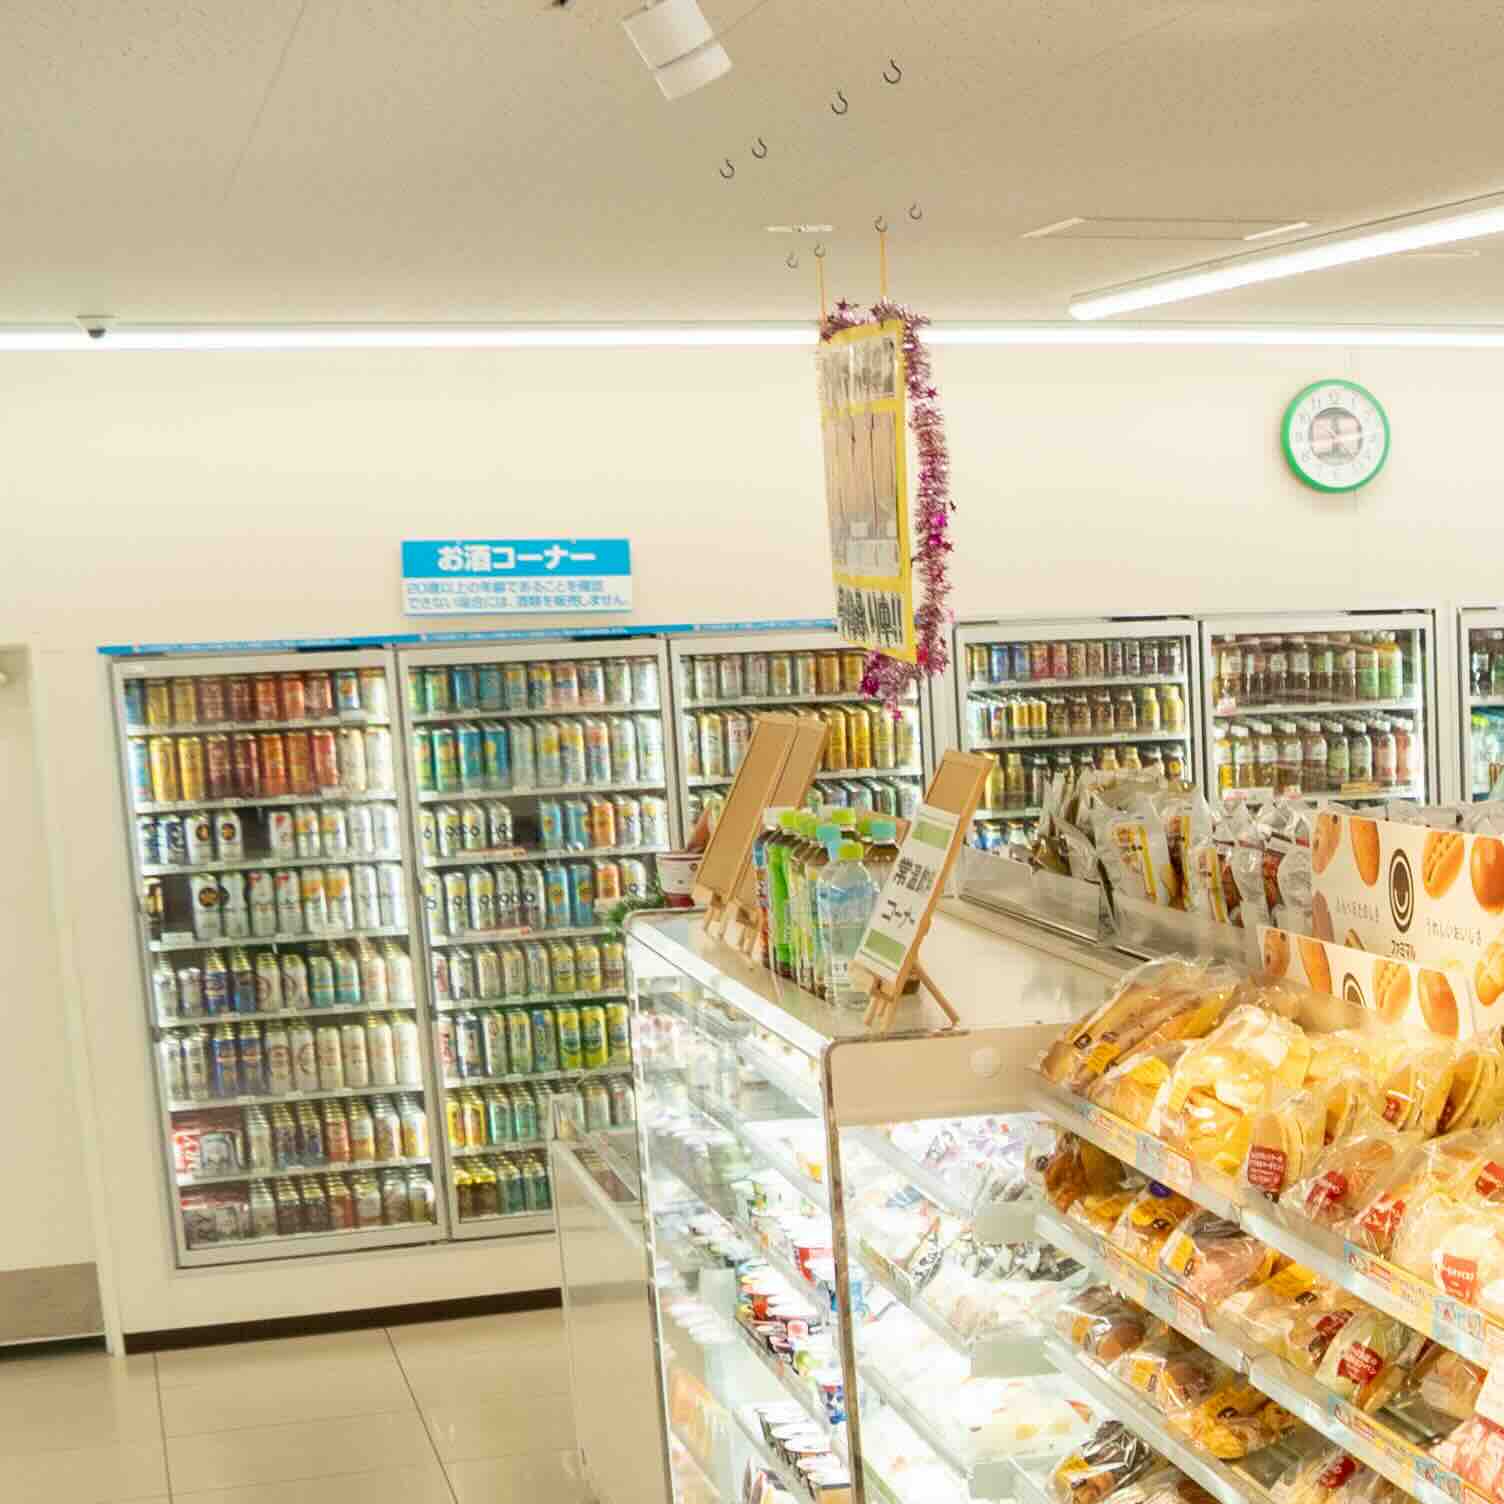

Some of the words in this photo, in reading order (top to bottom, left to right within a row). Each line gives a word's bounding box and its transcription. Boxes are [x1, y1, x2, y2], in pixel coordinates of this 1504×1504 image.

[437, 545, 596, 572] お酒コーナー
